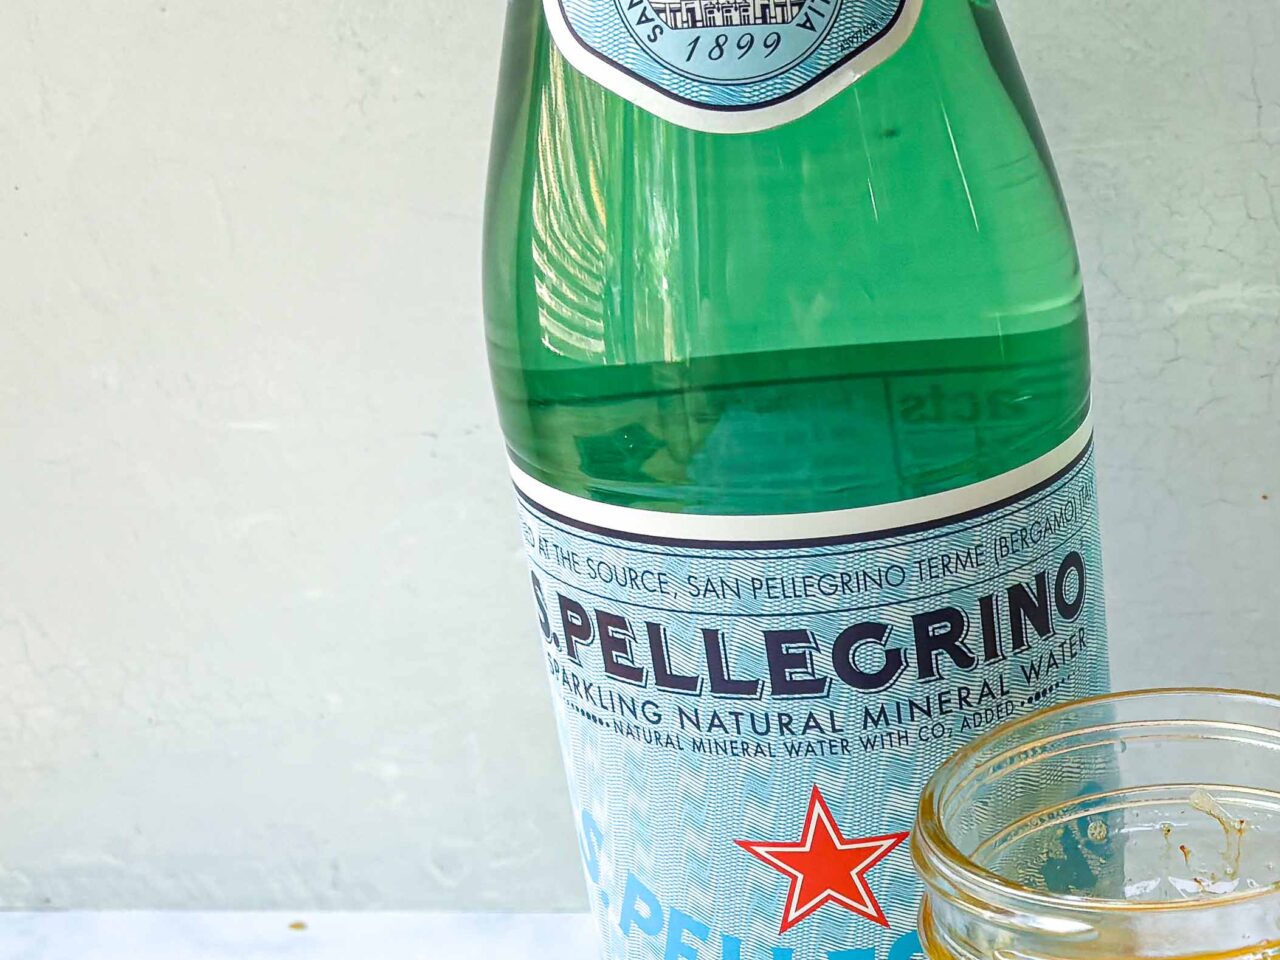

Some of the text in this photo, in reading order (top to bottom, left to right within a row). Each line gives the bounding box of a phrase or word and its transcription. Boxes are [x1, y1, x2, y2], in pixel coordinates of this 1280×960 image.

[685, 31, 782, 63] 1899
[538, 536, 552, 560] AT
[553, 543, 582, 575] THE
[586, 558, 678, 600] SOURCE,
[687, 576, 742, 600] SAN
[751, 565, 906, 600] PELLEGRINO
[916, 545, 985, 582] TERME
[531, 551, 1087, 701] S.PELLEGRINO
[547, 627, 1087, 737] SPARKLING NATURAL MINERAL WATER
[613, 717, 684, 751] NATURAL
[692, 737, 776, 758] MINERAL
[784, 737, 850, 758] WATER
[860, 728, 909, 751] WITH
[960, 700, 1015, 733] ADDED
